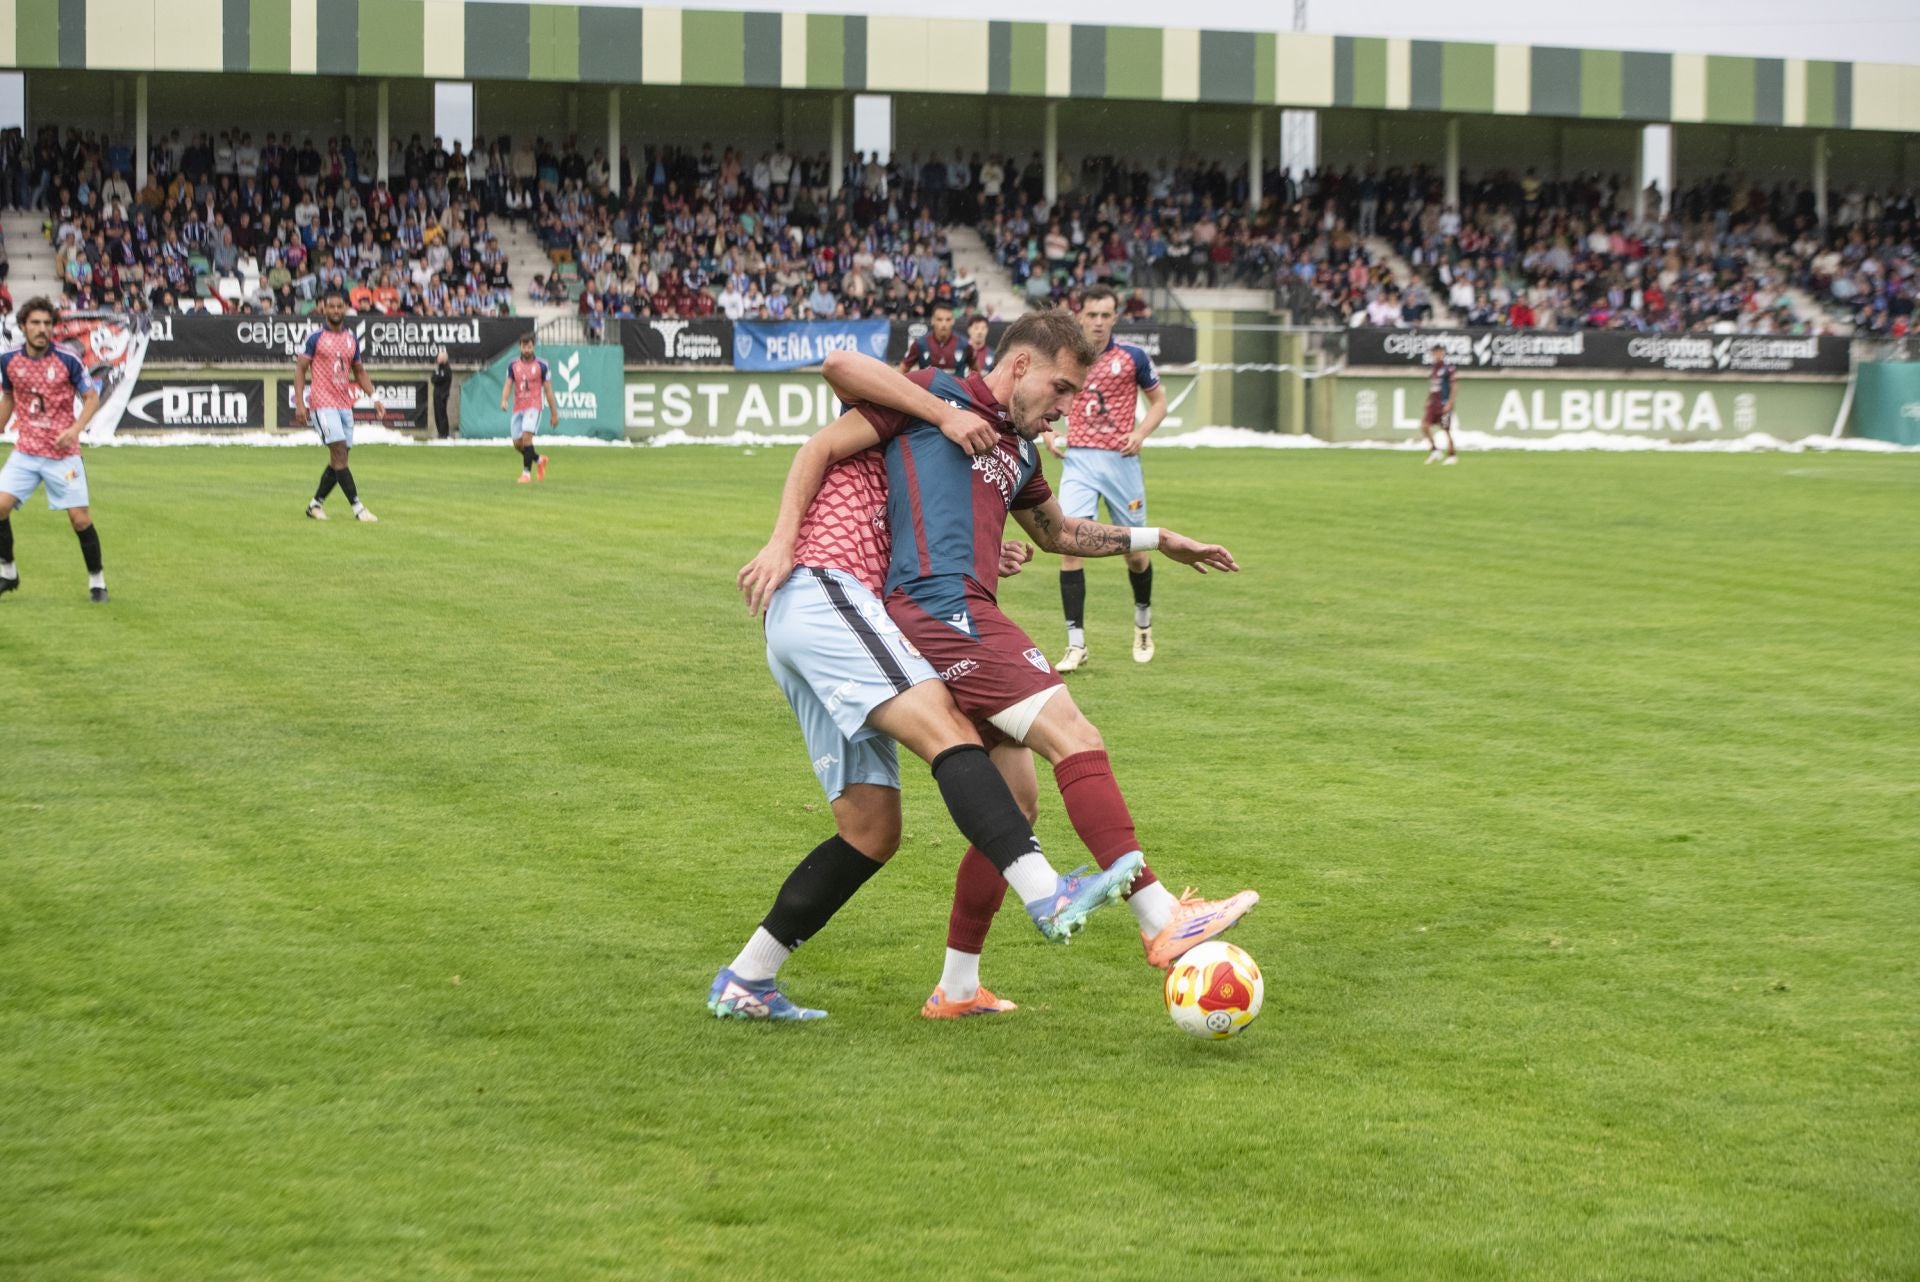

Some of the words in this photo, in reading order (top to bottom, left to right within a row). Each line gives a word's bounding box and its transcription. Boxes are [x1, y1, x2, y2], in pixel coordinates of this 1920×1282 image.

[237, 317, 323, 348] cajavi
[371, 318, 480, 349] cajarural
[678, 333, 711, 344] Turismo
[766, 333, 812, 361] PEÑA
[677, 344, 722, 359] Segovia
[163, 383, 247, 417] Drin
[1494, 389, 1722, 430] ALBUERA
